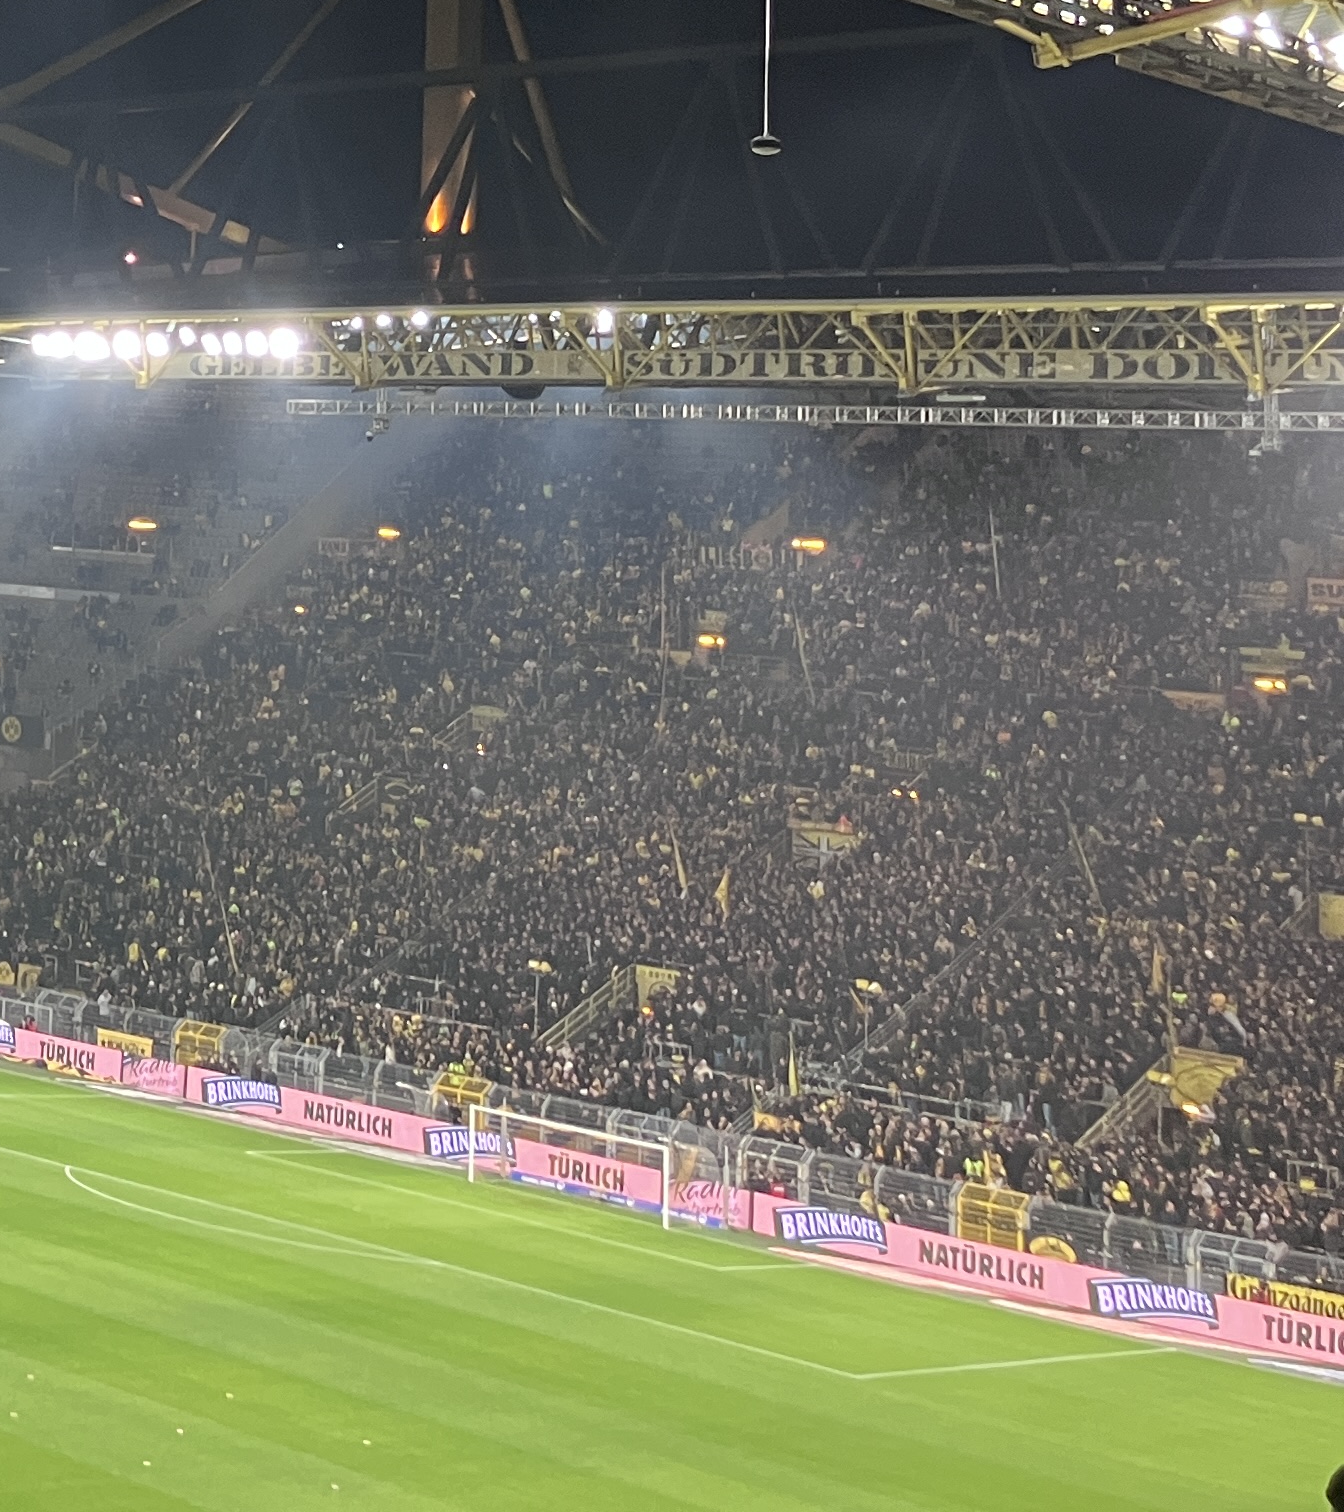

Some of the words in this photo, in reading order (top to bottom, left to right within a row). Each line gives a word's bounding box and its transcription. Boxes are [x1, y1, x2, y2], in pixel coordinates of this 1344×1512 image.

[377, 352, 534, 377] WAND
[40, 1039, 96, 1071] TÜRLICH
[303, 1098, 394, 1139] NATÜRLICH
[547, 1151, 625, 1193] TÜRLICH
[918, 1238, 1044, 1290] NATÜRLICH
